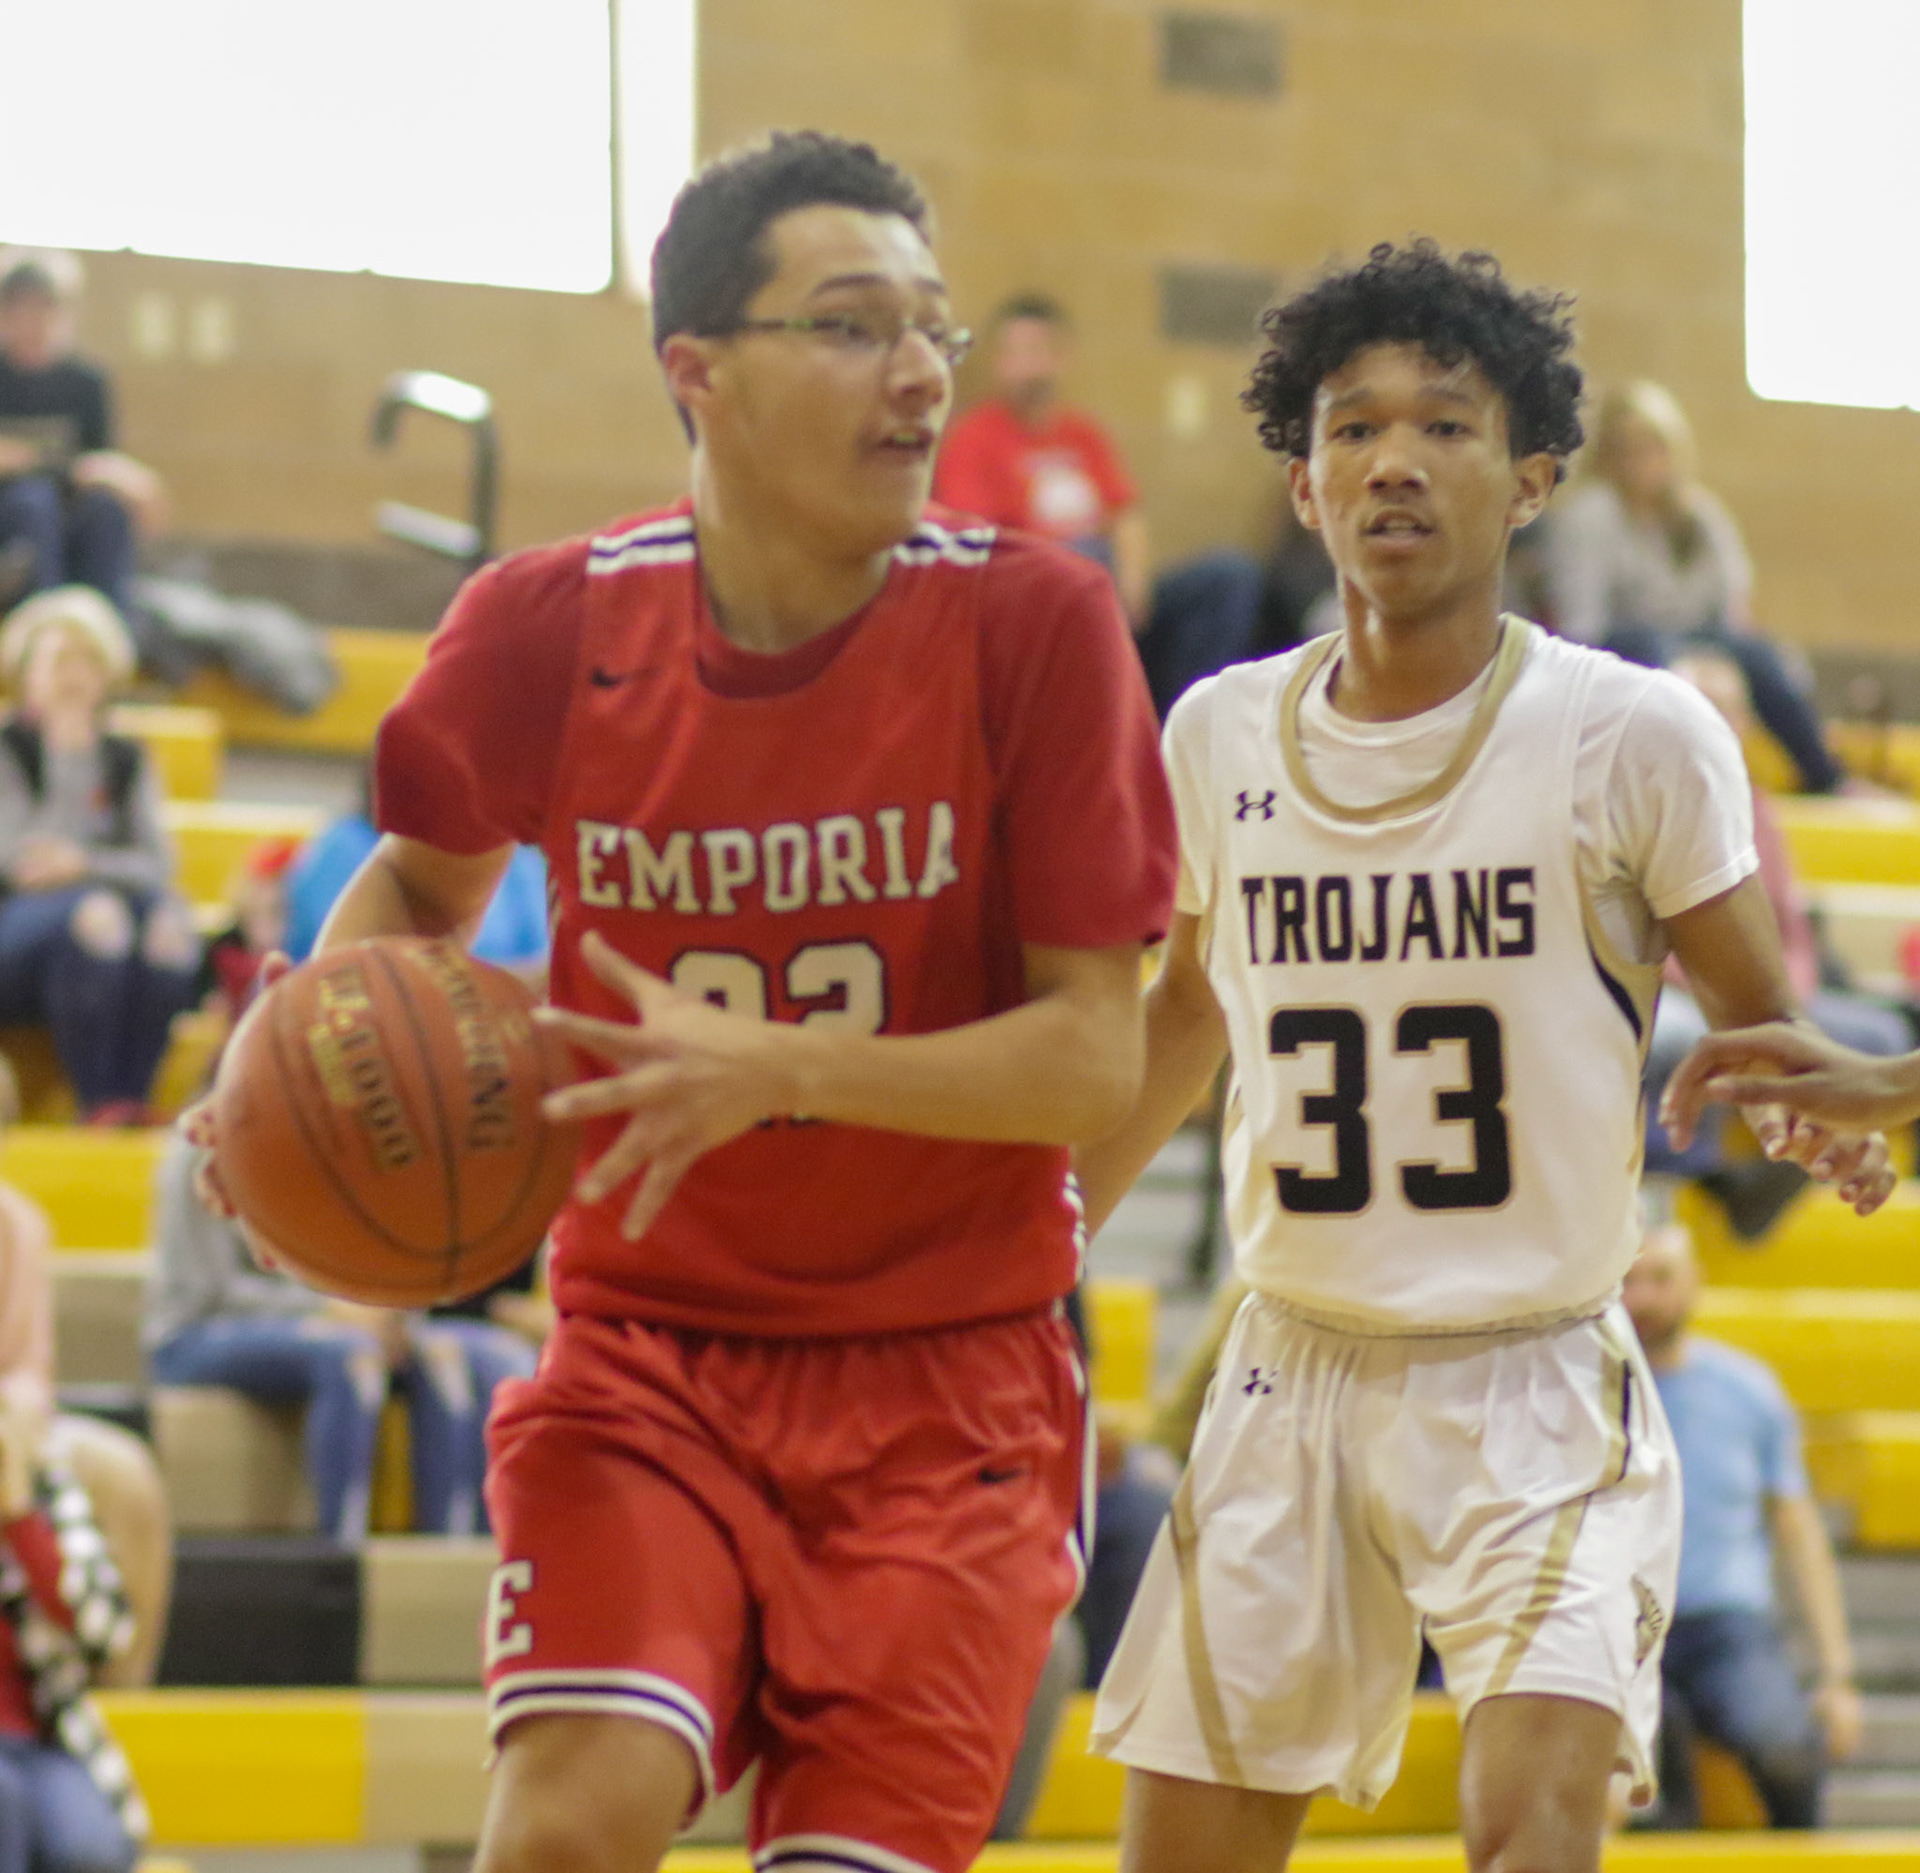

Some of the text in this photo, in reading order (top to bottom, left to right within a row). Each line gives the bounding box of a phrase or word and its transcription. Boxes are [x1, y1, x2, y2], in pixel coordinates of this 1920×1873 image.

[576, 801, 959, 914] EMPORIA
[1240, 866, 1537, 965] TROJANS
[1268, 1001, 1513, 1216] 33
[486, 1558, 533, 1667] E
